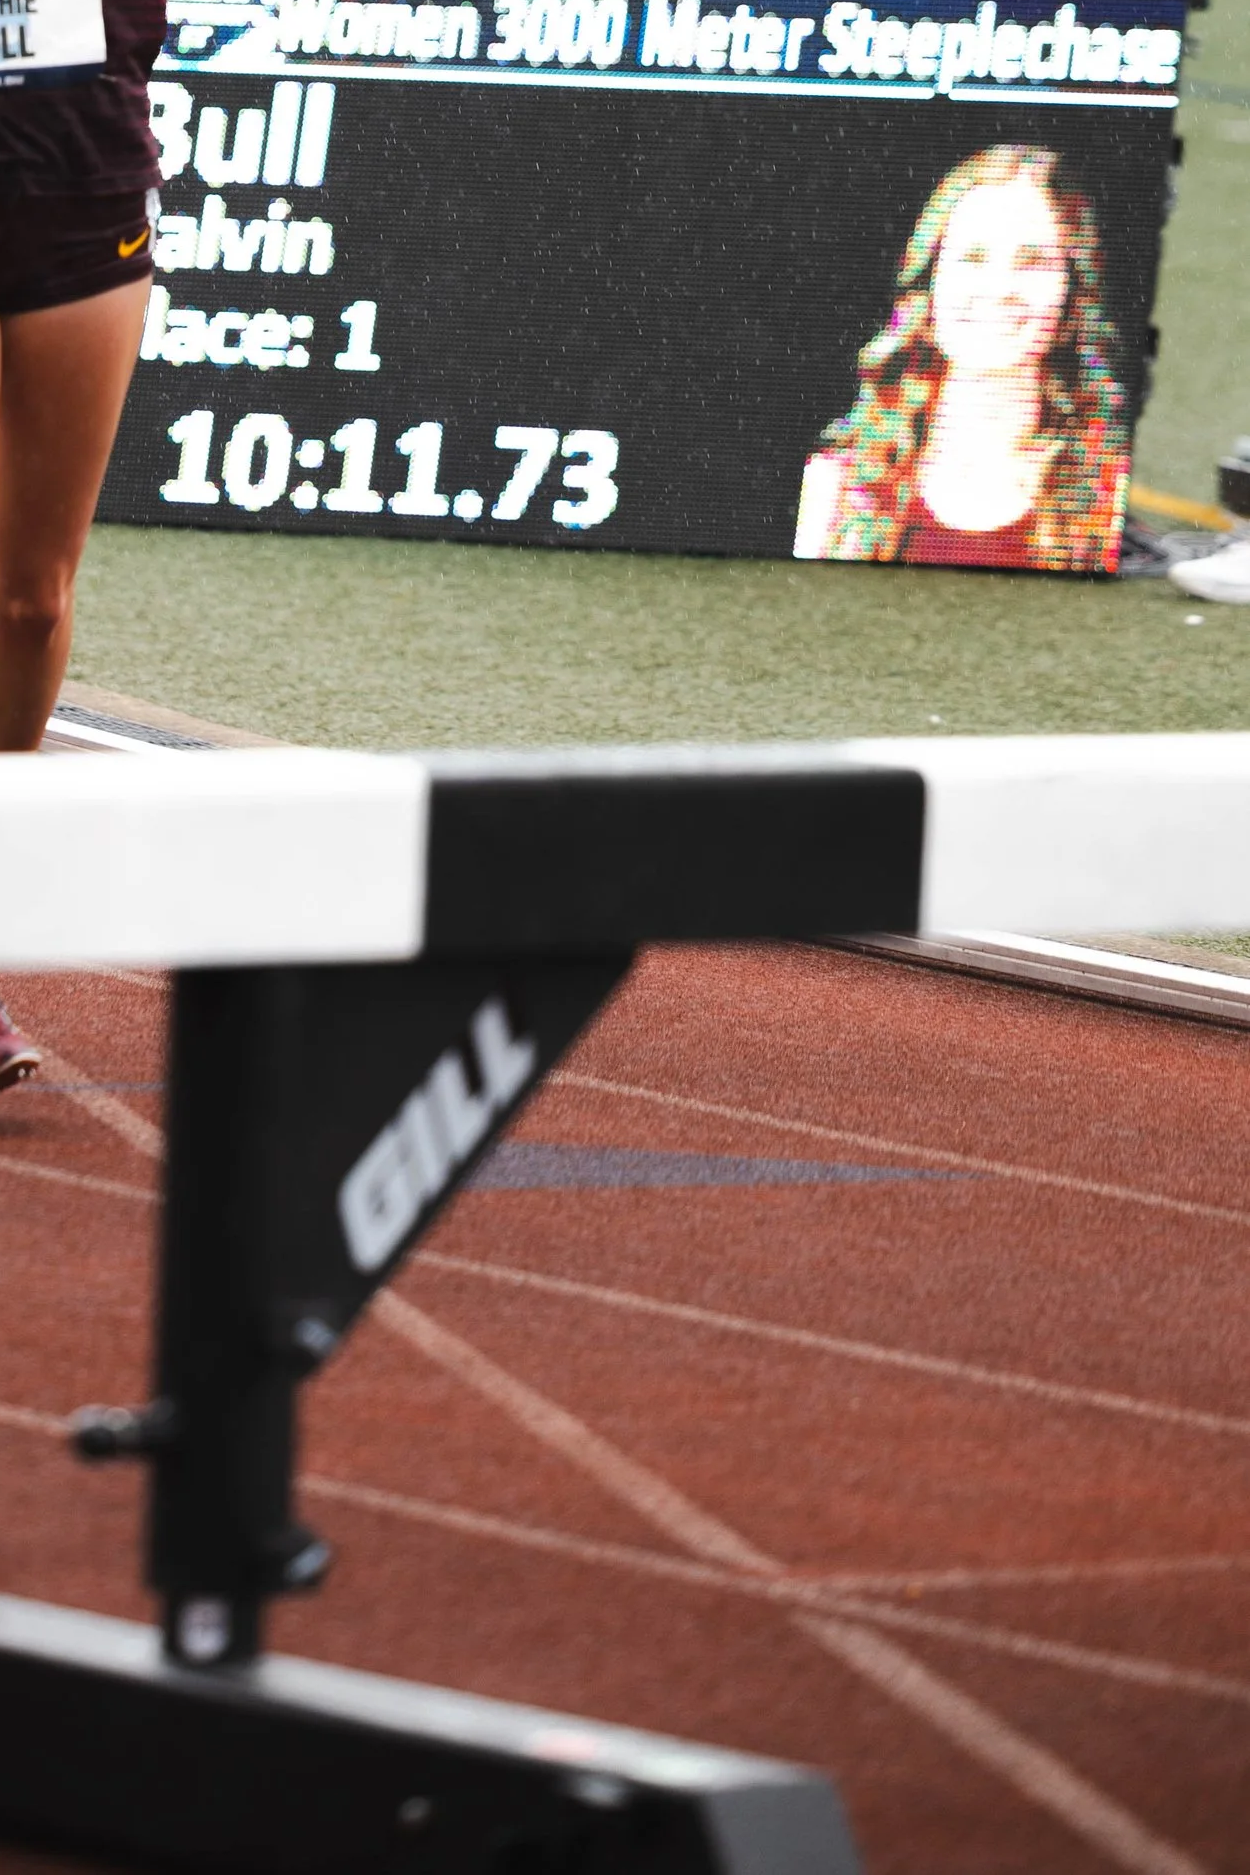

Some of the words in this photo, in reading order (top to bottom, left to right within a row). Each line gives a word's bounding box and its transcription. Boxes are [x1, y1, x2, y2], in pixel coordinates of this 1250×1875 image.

[818, 1, 1181, 94] Steeplechase
[147, 81, 335, 187] Bull
[152, 194, 335, 274] alvin
[140, 285, 314, 370] lace:
[334, 300, 381, 371] 1
[160, 410, 619, 529] 10:11.73
[338, 993, 537, 1272] GILL
